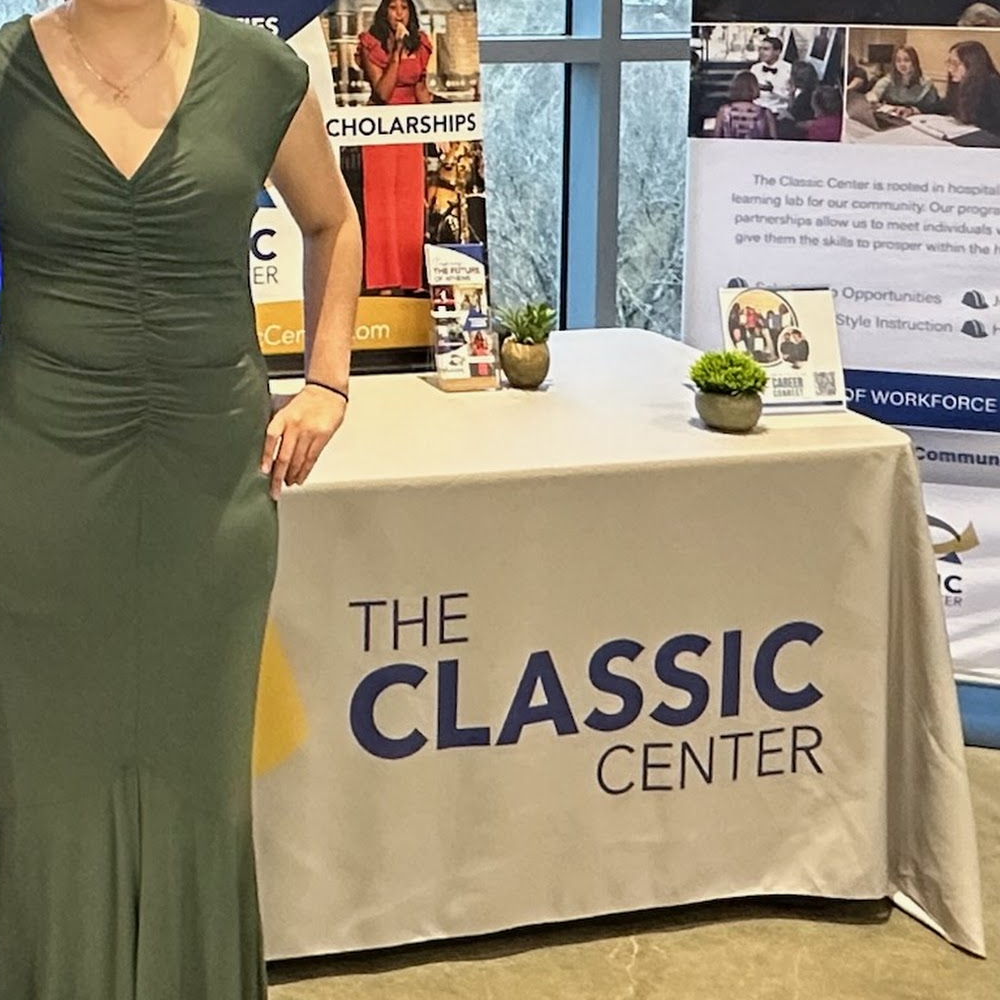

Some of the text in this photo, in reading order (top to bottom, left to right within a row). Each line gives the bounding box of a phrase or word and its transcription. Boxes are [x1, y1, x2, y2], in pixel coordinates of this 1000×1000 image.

[325, 112, 477, 137] CHOLARSHIPS
[753, 174, 777, 187] The
[779, 175, 825, 188] Classic
[827, 177, 869, 190] Center
[932, 183, 945, 193] in
[731, 192, 782, 208] learning
[785, 194, 804, 207] lab
[807, 195, 825, 208] for
[827, 199, 849, 209] our
[929, 201, 955, 214] Our
[734, 212, 813, 229] partnerships
[815, 215, 849, 228] allow
[852, 219, 868, 229] us
[871, 219, 884, 230] to
[887, 220, 920, 232] meet
[922, 221, 993, 236] individuals
[734, 232, 761, 246] give
[764, 232, 796, 245] them
[799, 233, 820, 246] the
[822, 235, 854, 248] skills
[857, 238, 870, 249] to
[873, 239, 923, 252] prosper
[925, 241, 966, 254] within
[969, 242, 991, 256] the
[842, 286, 943, 305] Opportunities
[876, 316, 954, 333] Instruction
[870, 389, 998, 413] WORKFORCE
[348, 591, 470, 653] THE
[348, 620, 825, 761] CLASSIC
[596, 724, 824, 796] CENTER
